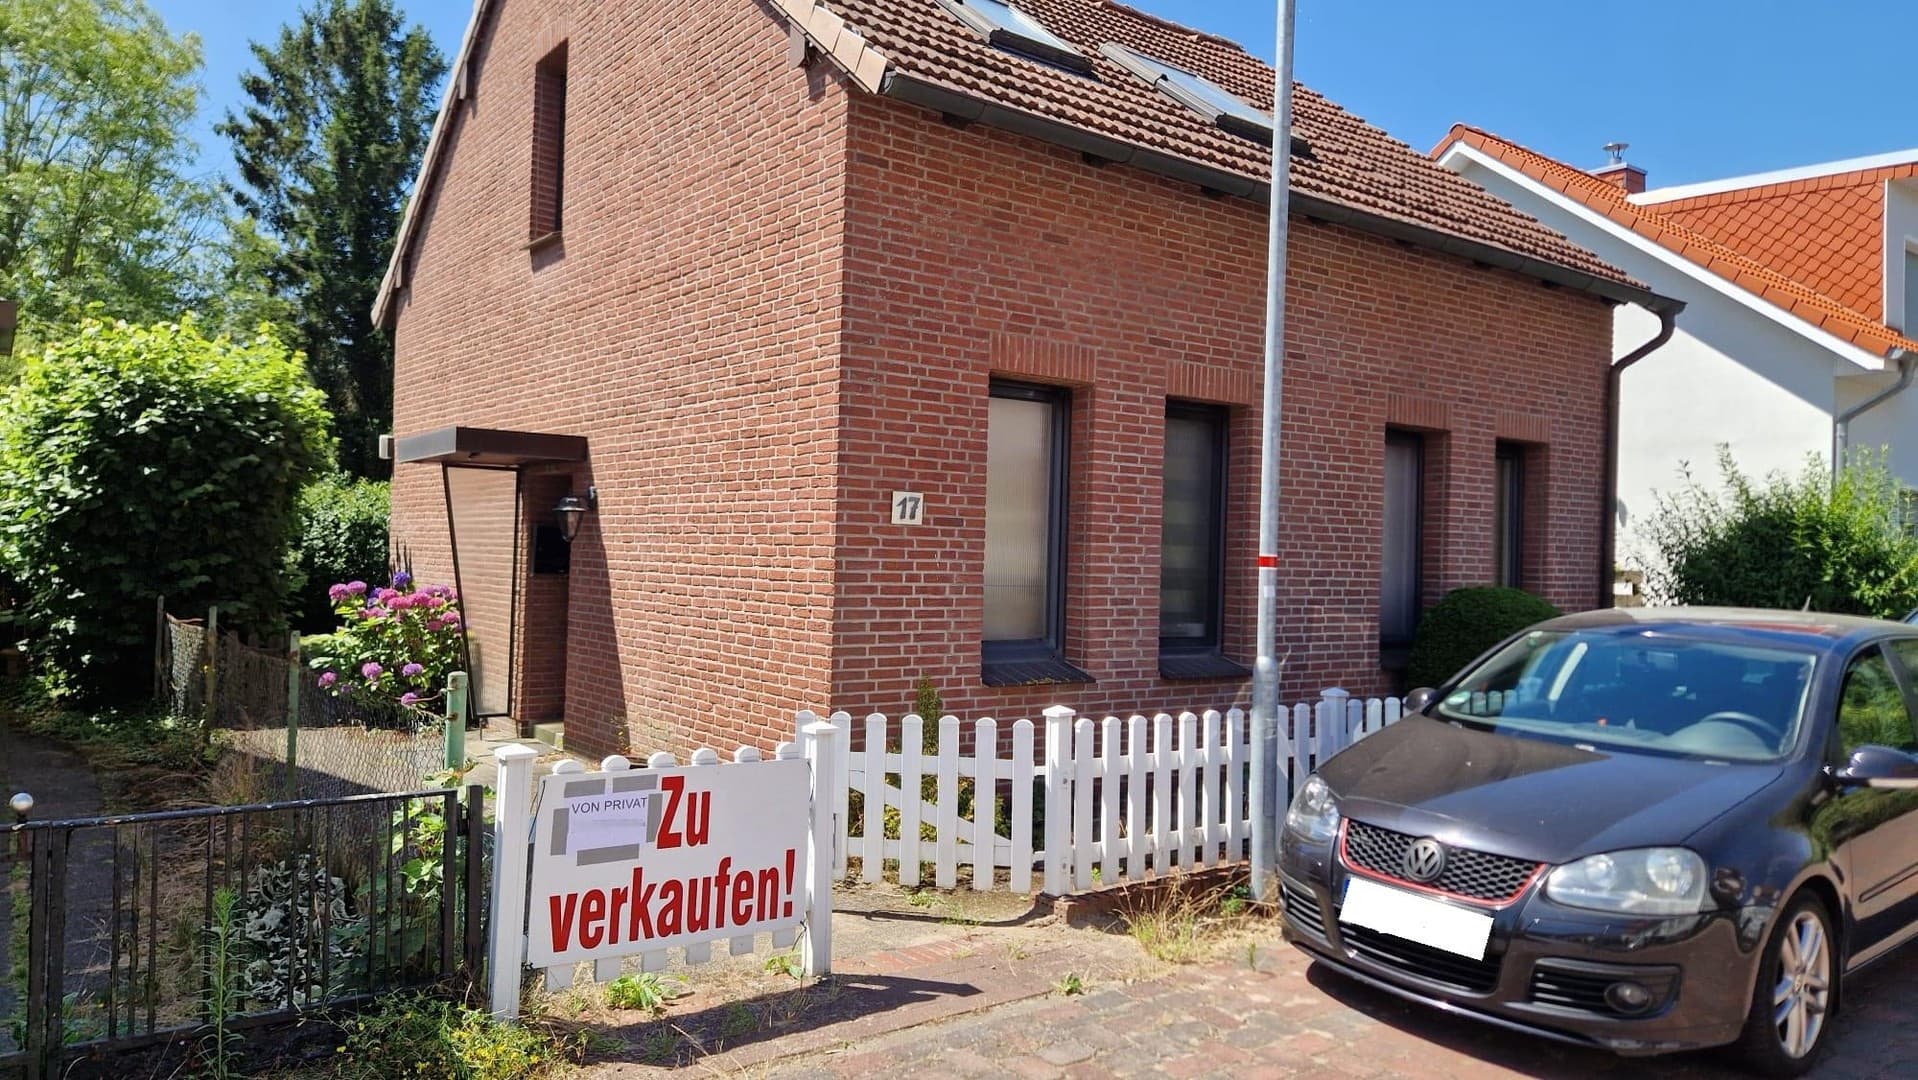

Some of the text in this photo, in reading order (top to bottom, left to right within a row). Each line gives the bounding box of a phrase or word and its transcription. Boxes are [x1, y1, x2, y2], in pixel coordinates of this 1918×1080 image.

[896, 496, 921, 520] 17
[571, 797, 648, 814] VON PRIVAT
[656, 775, 711, 849] Zu
[1406, 840, 1441, 879] VW
[548, 848, 796, 953] verkaufen!
